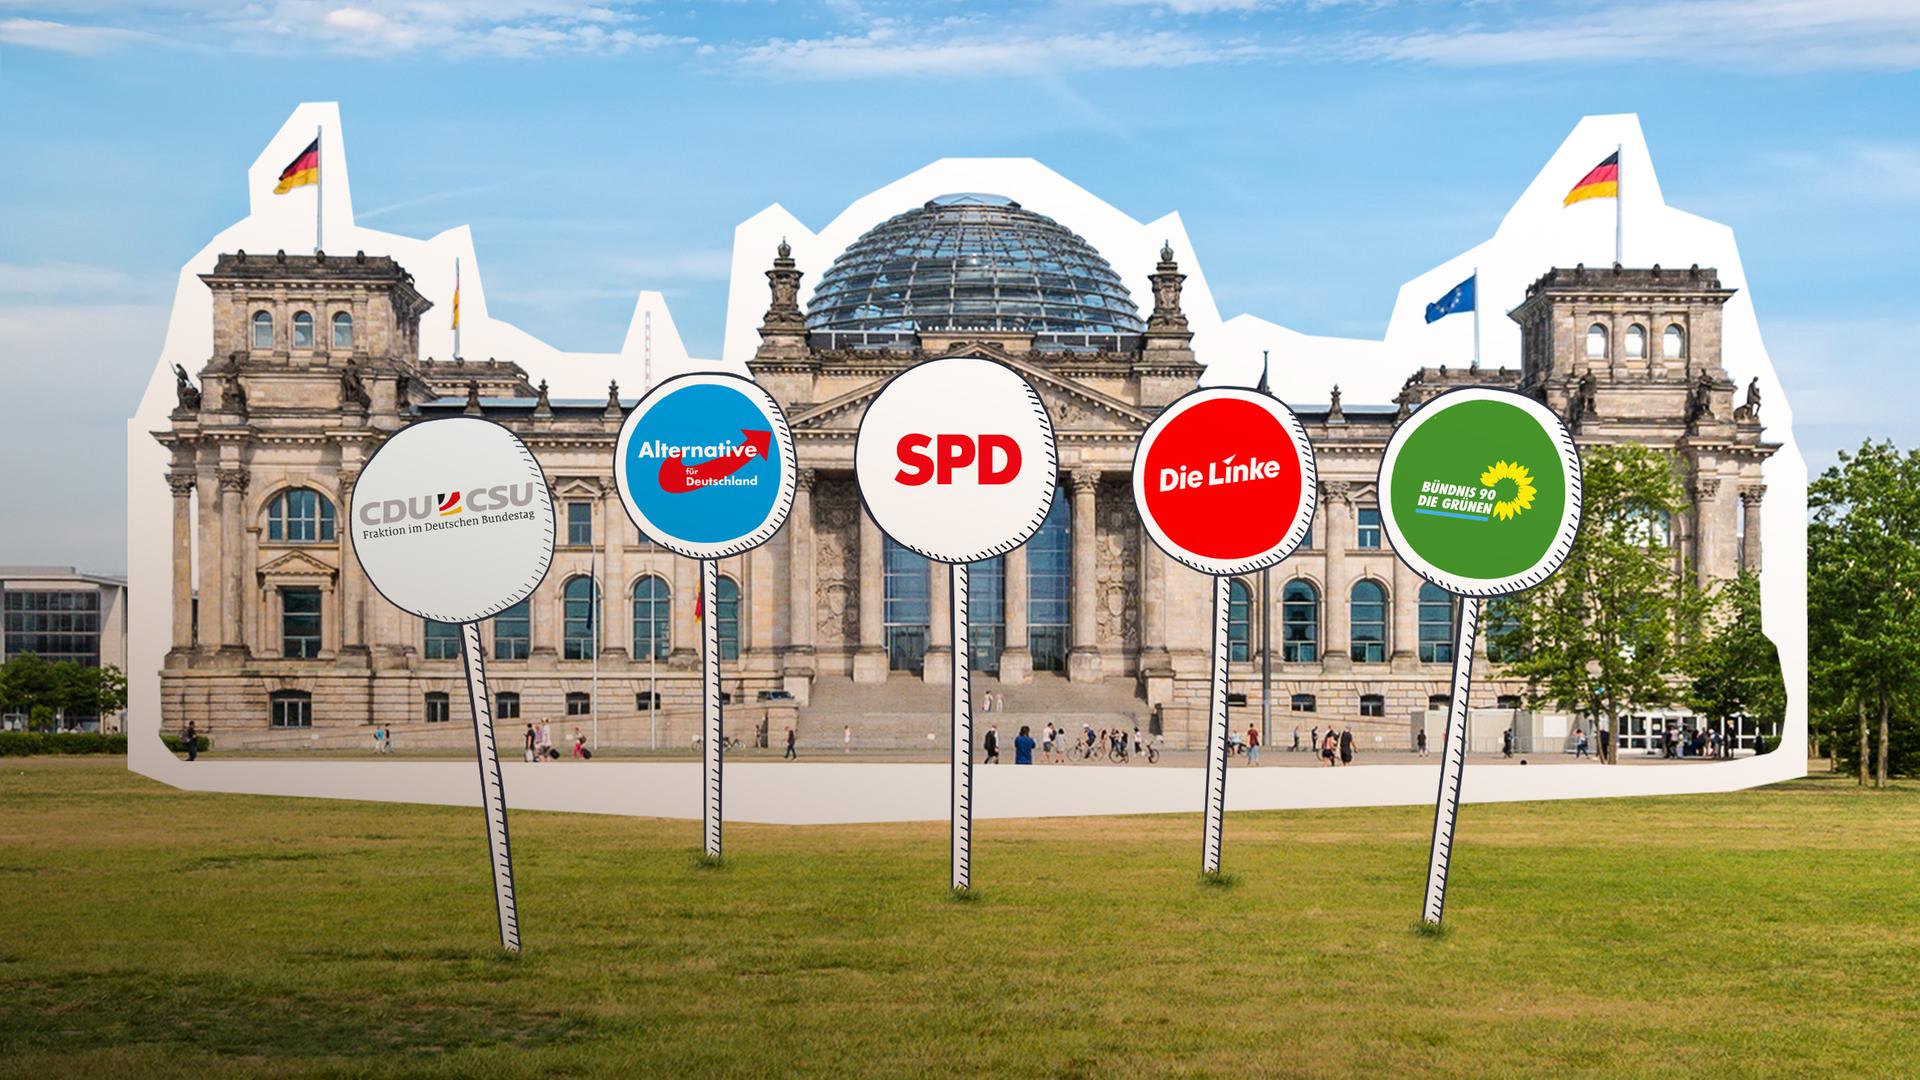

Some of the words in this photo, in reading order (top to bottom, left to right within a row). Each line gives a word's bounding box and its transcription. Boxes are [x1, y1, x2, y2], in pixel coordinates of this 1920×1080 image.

[638, 440, 757, 458] Alternative
[894, 433, 1022, 486] SPD
[686, 467, 698, 475] für
[686, 475, 758, 486] Deutschland
[1160, 465, 1203, 492] Die
[1208, 454, 1280, 486] Linke
[1421, 480, 1477, 498] BÜNDNIS
[1480, 489, 1496, 500] 90
[360, 495, 432, 526] CDU
[466, 482, 533, 512] CSU
[1417, 495, 1438, 507] DIE
[1442, 497, 1493, 514] GRÜNEN
[363, 526, 406, 539] Fraktion
[408, 524, 422, 534] im
[425, 516, 479, 532] Deutschen
[482, 510, 536, 524] Bundestag
